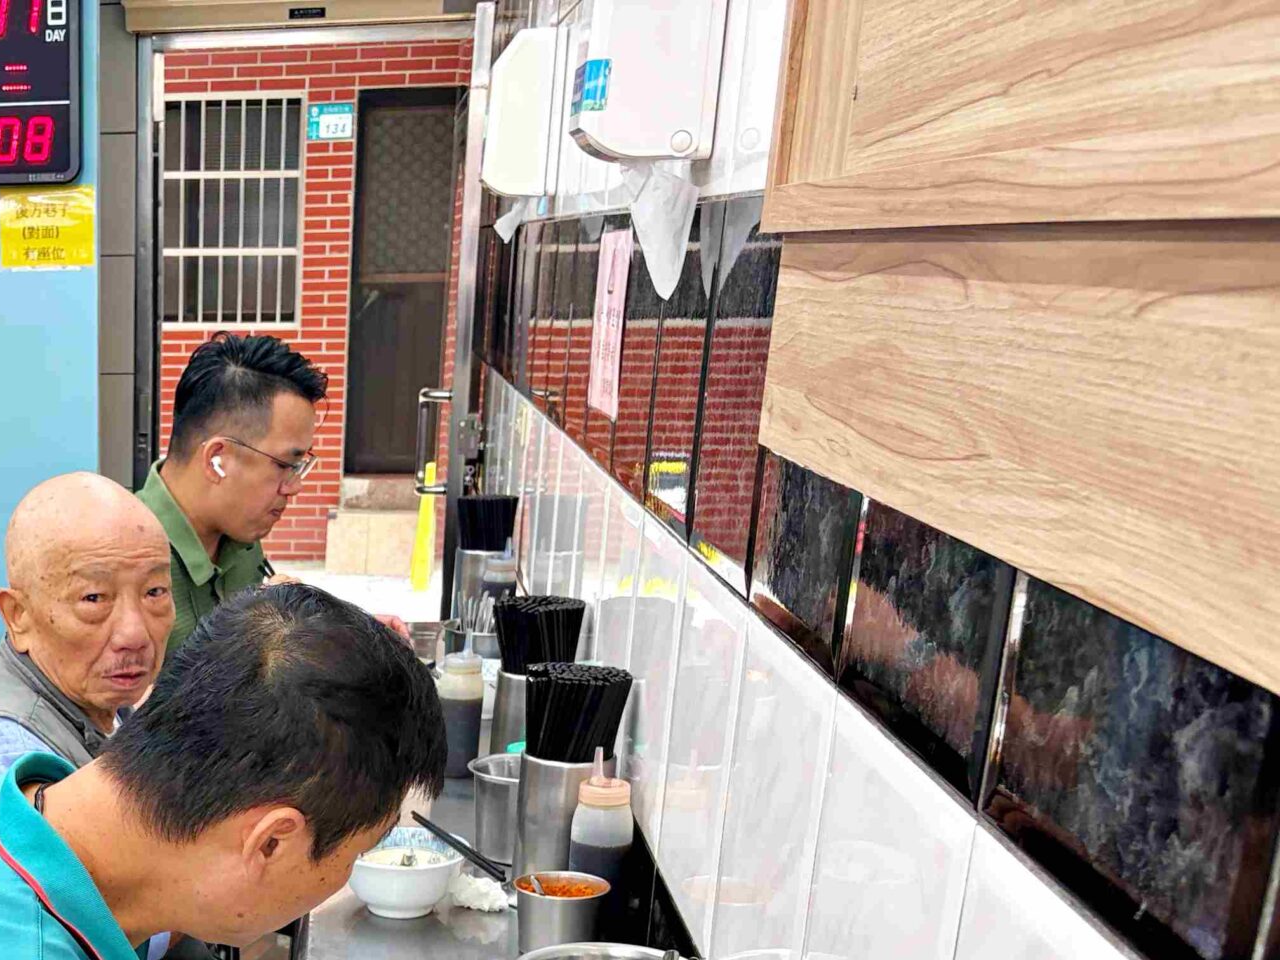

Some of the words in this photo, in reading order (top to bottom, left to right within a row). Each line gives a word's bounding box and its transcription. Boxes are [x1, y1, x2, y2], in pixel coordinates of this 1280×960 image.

[45, 29, 66, 42] DAY
[22, 225, 60, 240] (對面)
[23, 246, 66, 261] 有座位
